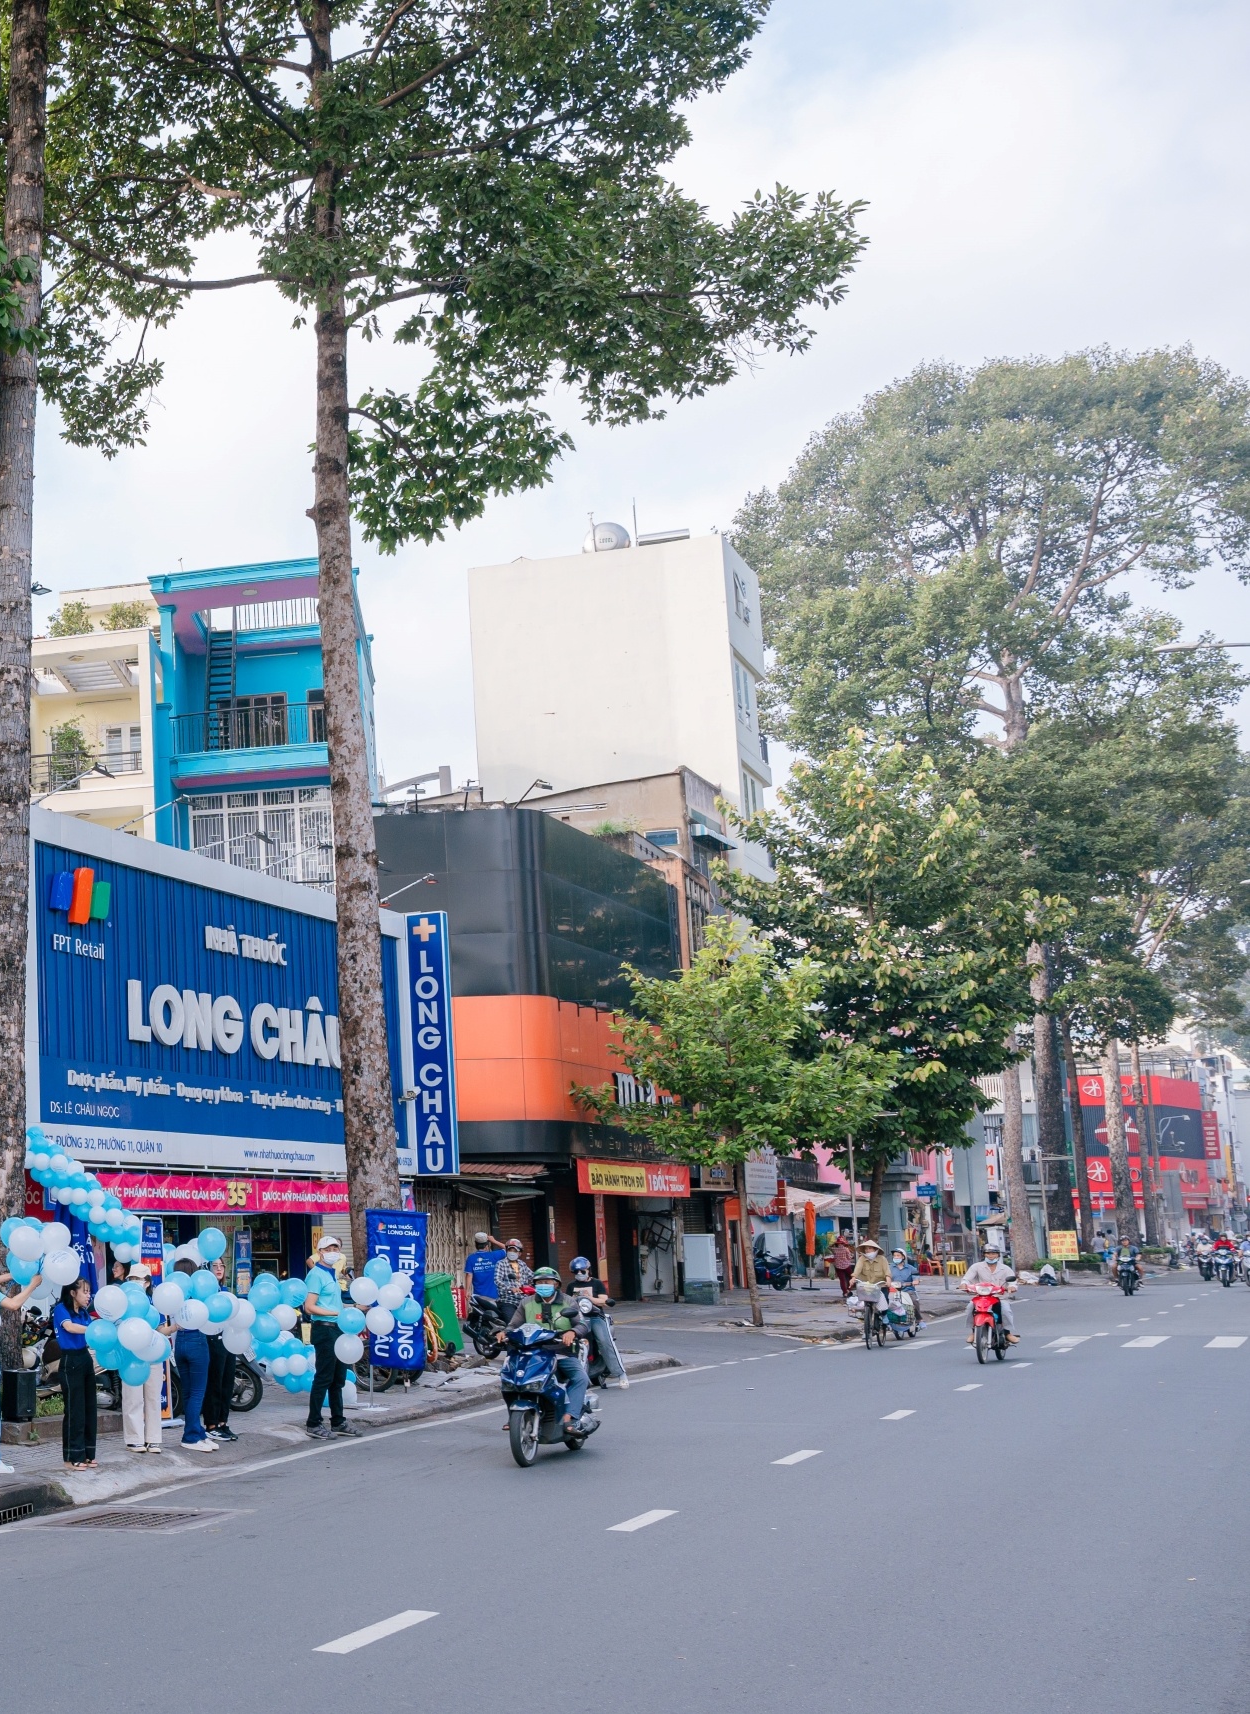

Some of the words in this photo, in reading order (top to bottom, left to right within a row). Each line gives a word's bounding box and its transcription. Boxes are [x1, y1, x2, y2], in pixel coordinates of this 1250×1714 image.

[53, 933, 72, 954] FPT
[75, 937, 105, 960] Retail
[205, 925, 238, 955] NHÀ
[239, 933, 288, 966] THUỐC
[415, 950, 442, 1050] LONG
[127, 979, 244, 1054] LONG
[50, 1100, 63, 1114] DS:
[64, 1100, 72, 1114] LÊ
[75, 1102, 95, 1116] CHÂU
[97, 1105, 120, 1119] NGỌC
[419, 1062, 446, 1172] CHÂU
[56, 1134, 83, 1149] ĐƯỜNG
[97, 1137, 127, 1152] PHƯỜNG
[136, 1141, 155, 1154] QUẬN
[156, 1142, 163, 1153] 10
[244, 1149, 316, 1163] www.nhathuoclongchau.com
[591, 1168, 604, 1185] BẢO
[604, 1170, 620, 1187] HÀNH
